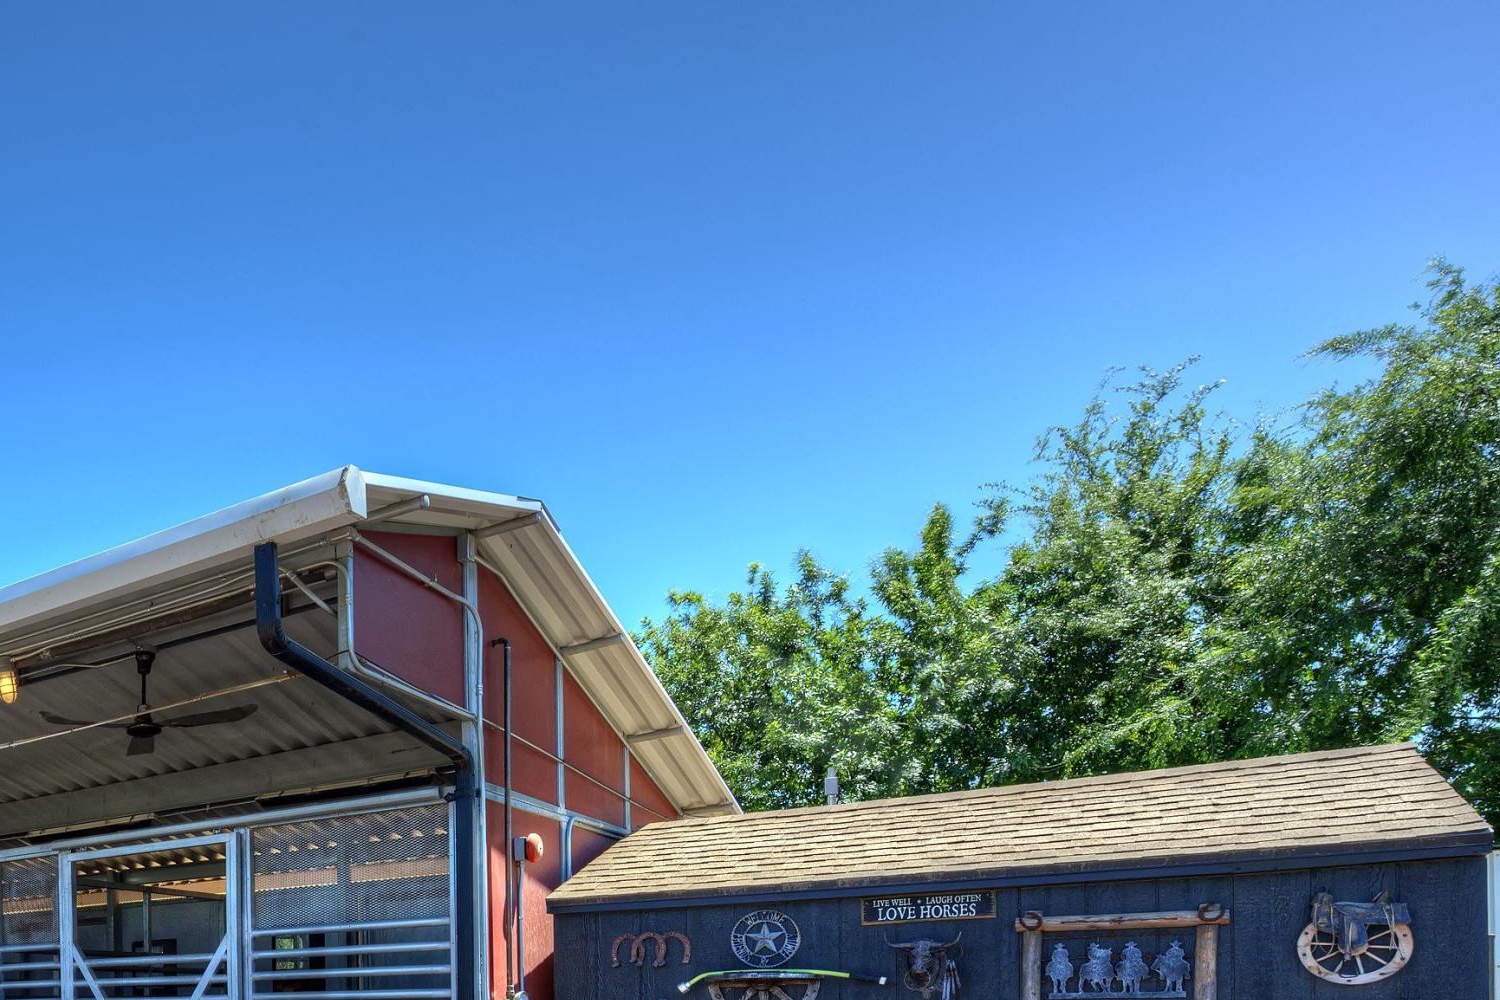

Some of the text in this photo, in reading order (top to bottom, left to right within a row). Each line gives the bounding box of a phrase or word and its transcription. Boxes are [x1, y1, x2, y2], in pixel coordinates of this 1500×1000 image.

[873, 894, 982, 908] LIVE WELL LAUGH OFTEN
[878, 903, 977, 921] LOVE HORSES
